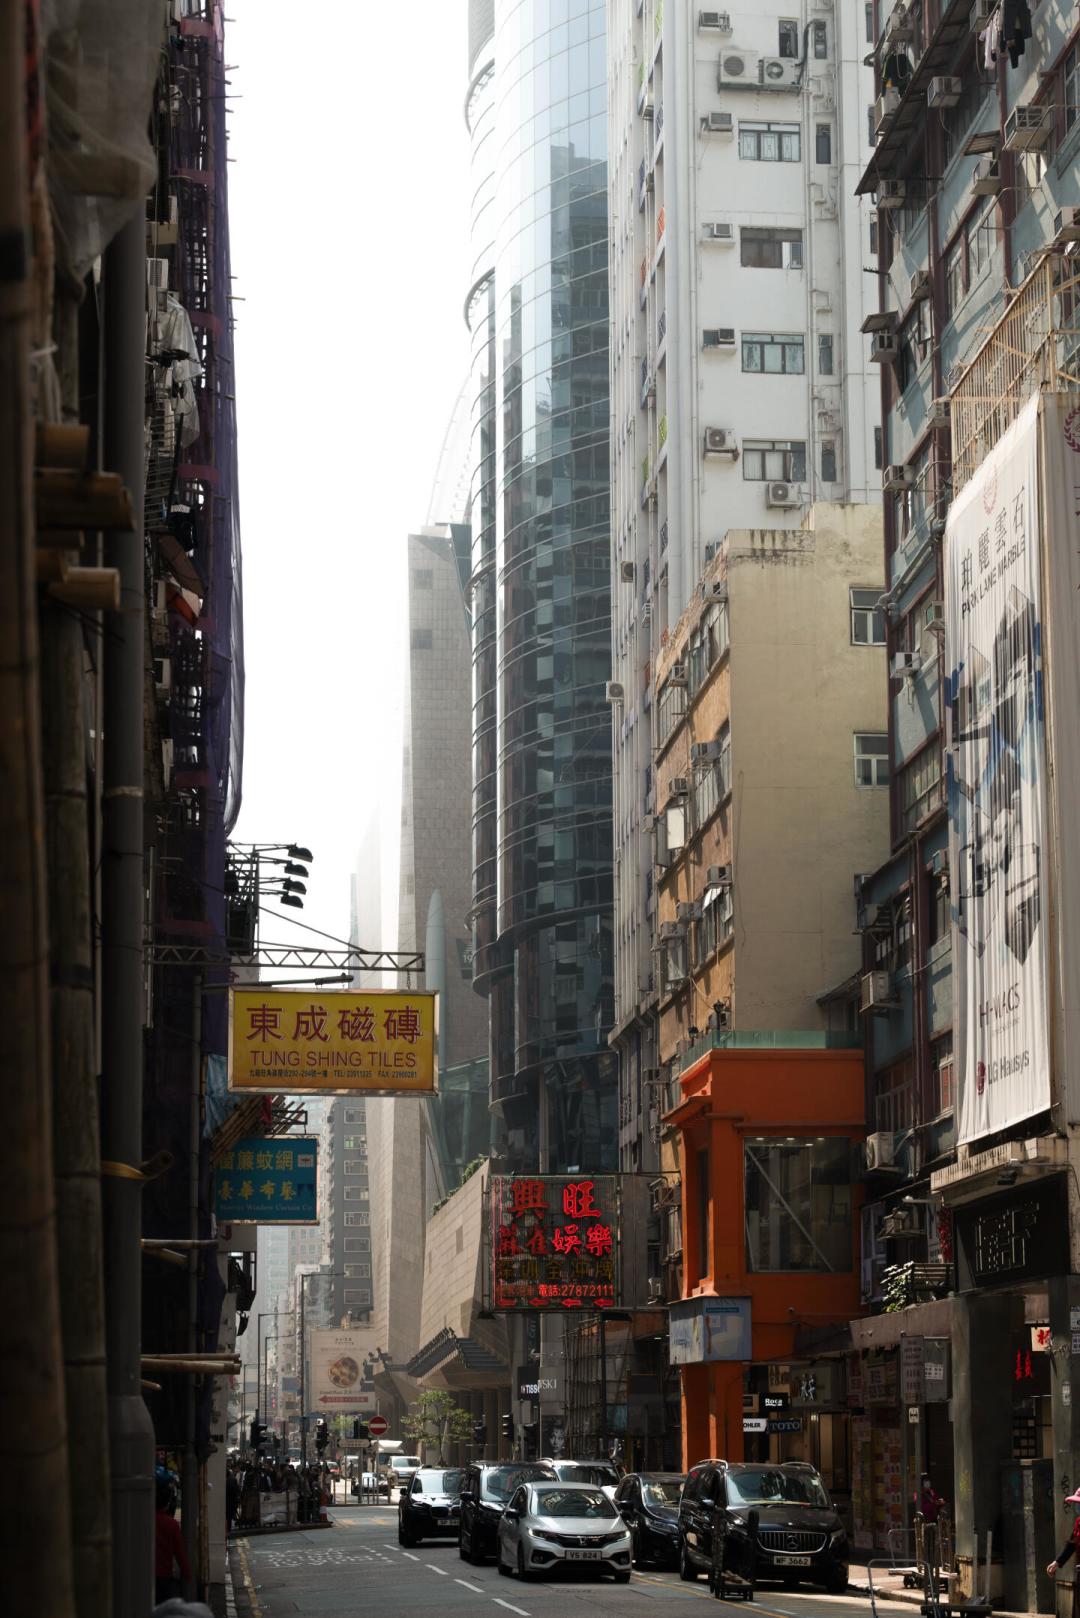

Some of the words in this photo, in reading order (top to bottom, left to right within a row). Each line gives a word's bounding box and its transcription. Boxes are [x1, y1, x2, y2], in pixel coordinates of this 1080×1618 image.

[961, 588, 978, 620] PARK
[979, 568, 997, 599] LANE
[998, 534, 1026, 577] MARBLE
[246, 1004, 421, 1044] 東成磁磚
[250, 1051, 300, 1067] TUNG
[306, 1051, 361, 1067] SHING
[368, 1052, 416, 1068] TILES
[988, 1061, 998, 1085] LG
[1000, 1050, 1029, 1080] Hausys
[508, 1179, 601, 1219] 興旺
[771, 1422, 800, 1431] TOTO
